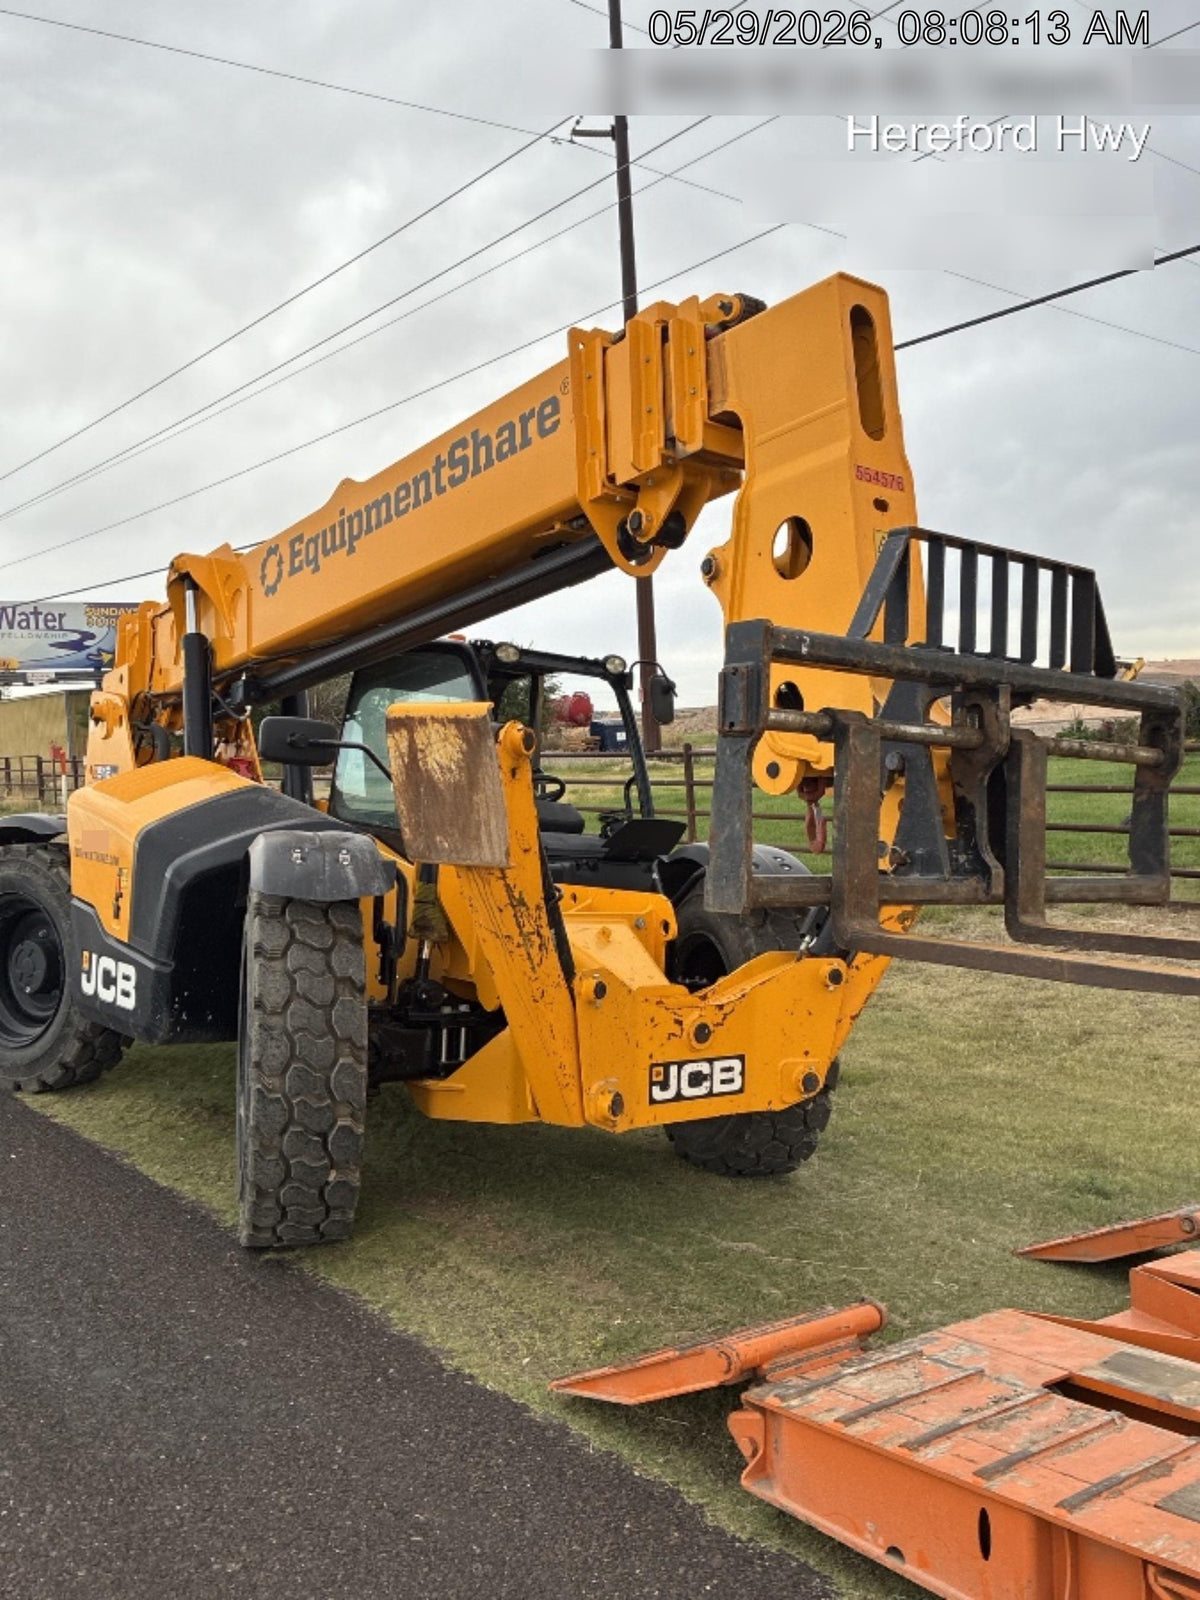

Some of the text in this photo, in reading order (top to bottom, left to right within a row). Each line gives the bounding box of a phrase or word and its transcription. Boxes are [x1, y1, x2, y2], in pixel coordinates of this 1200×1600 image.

[288, 394, 561, 578] EquipmentShare
[81, 950, 137, 1011] JCB
[651, 1059, 742, 1101] JCB
